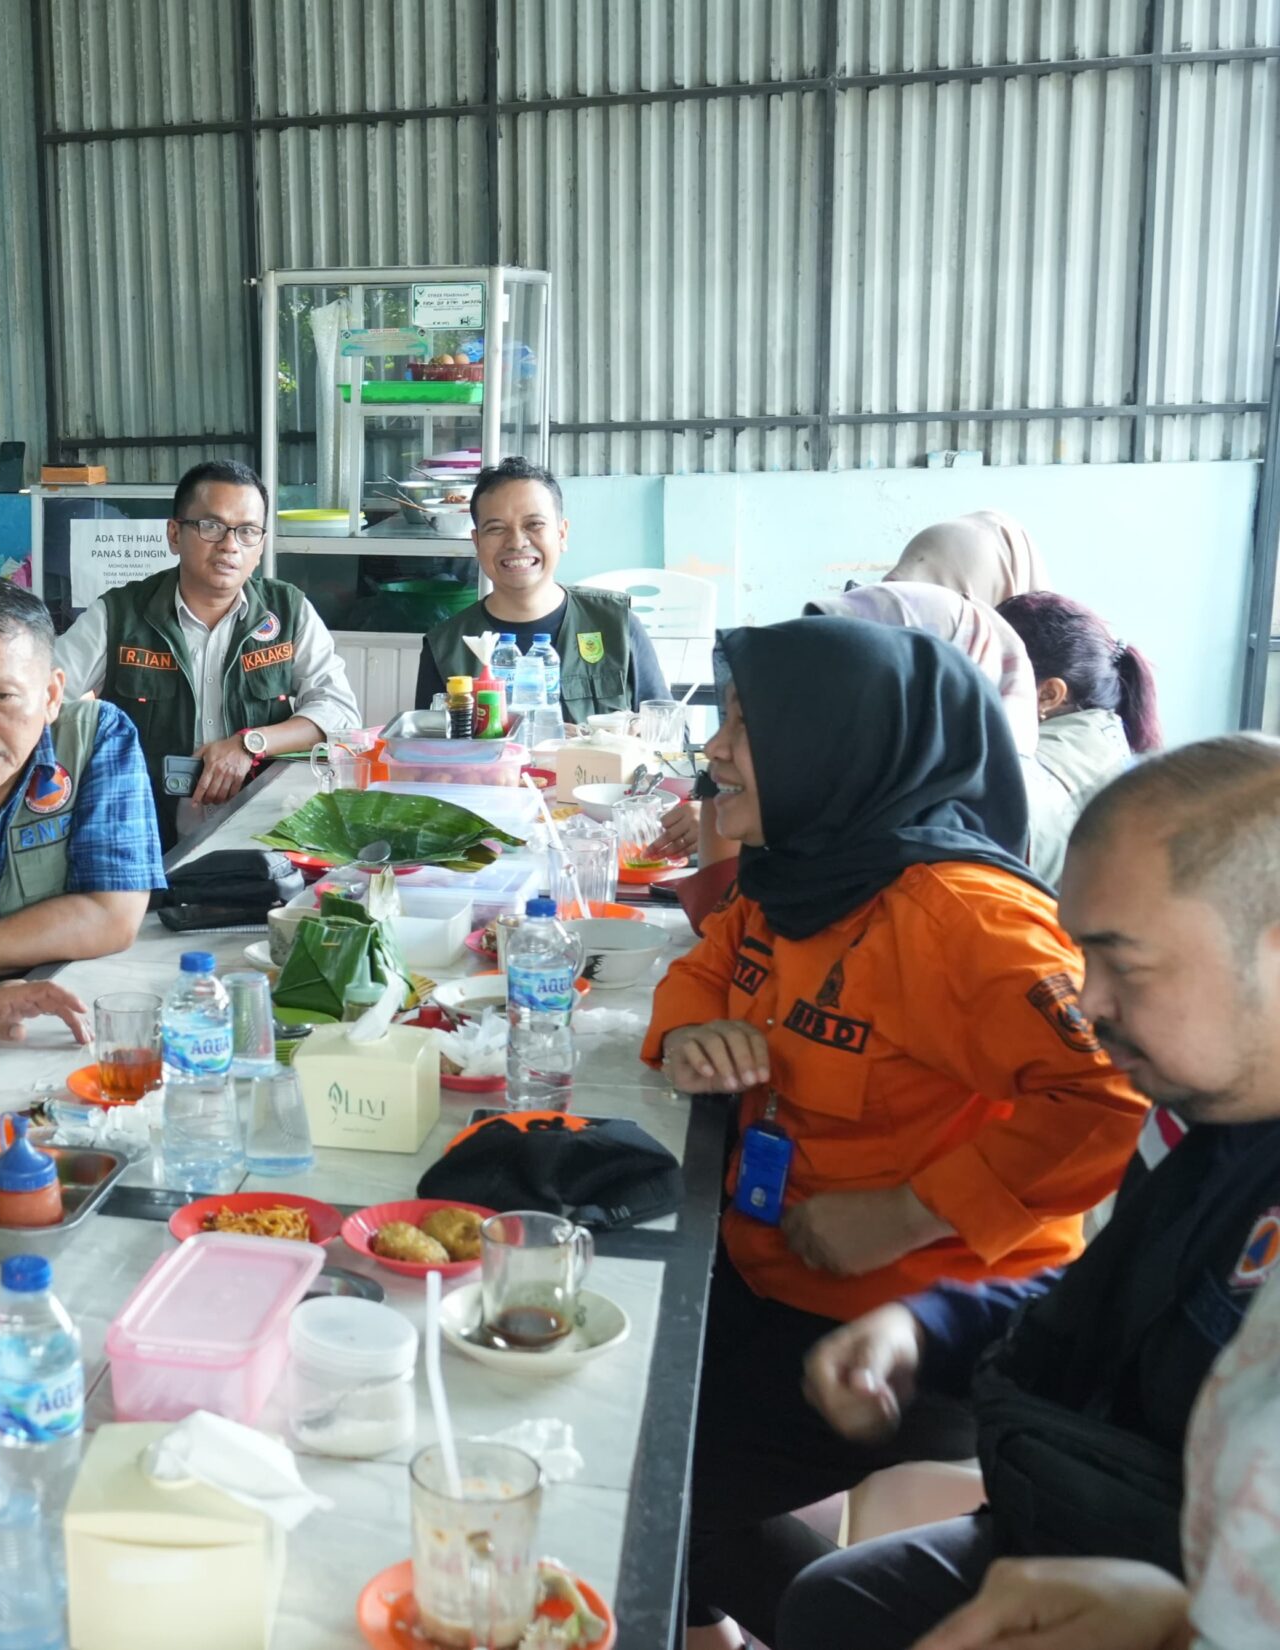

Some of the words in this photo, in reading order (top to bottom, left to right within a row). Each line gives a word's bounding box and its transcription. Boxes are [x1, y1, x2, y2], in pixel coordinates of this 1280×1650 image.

[95, 534, 114, 543] ADA
[117, 534, 133, 543] TEH
[136, 534, 162, 543] HIJAU
[91, 550, 121, 558] PANAS
[124, 550, 131, 558] &
[134, 550, 166, 558] DINGIN
[126, 650, 140, 664] R.
[145, 652, 171, 667] IAN
[20, 815, 72, 848] BNP
[191, 1036, 230, 1055] AQUA
